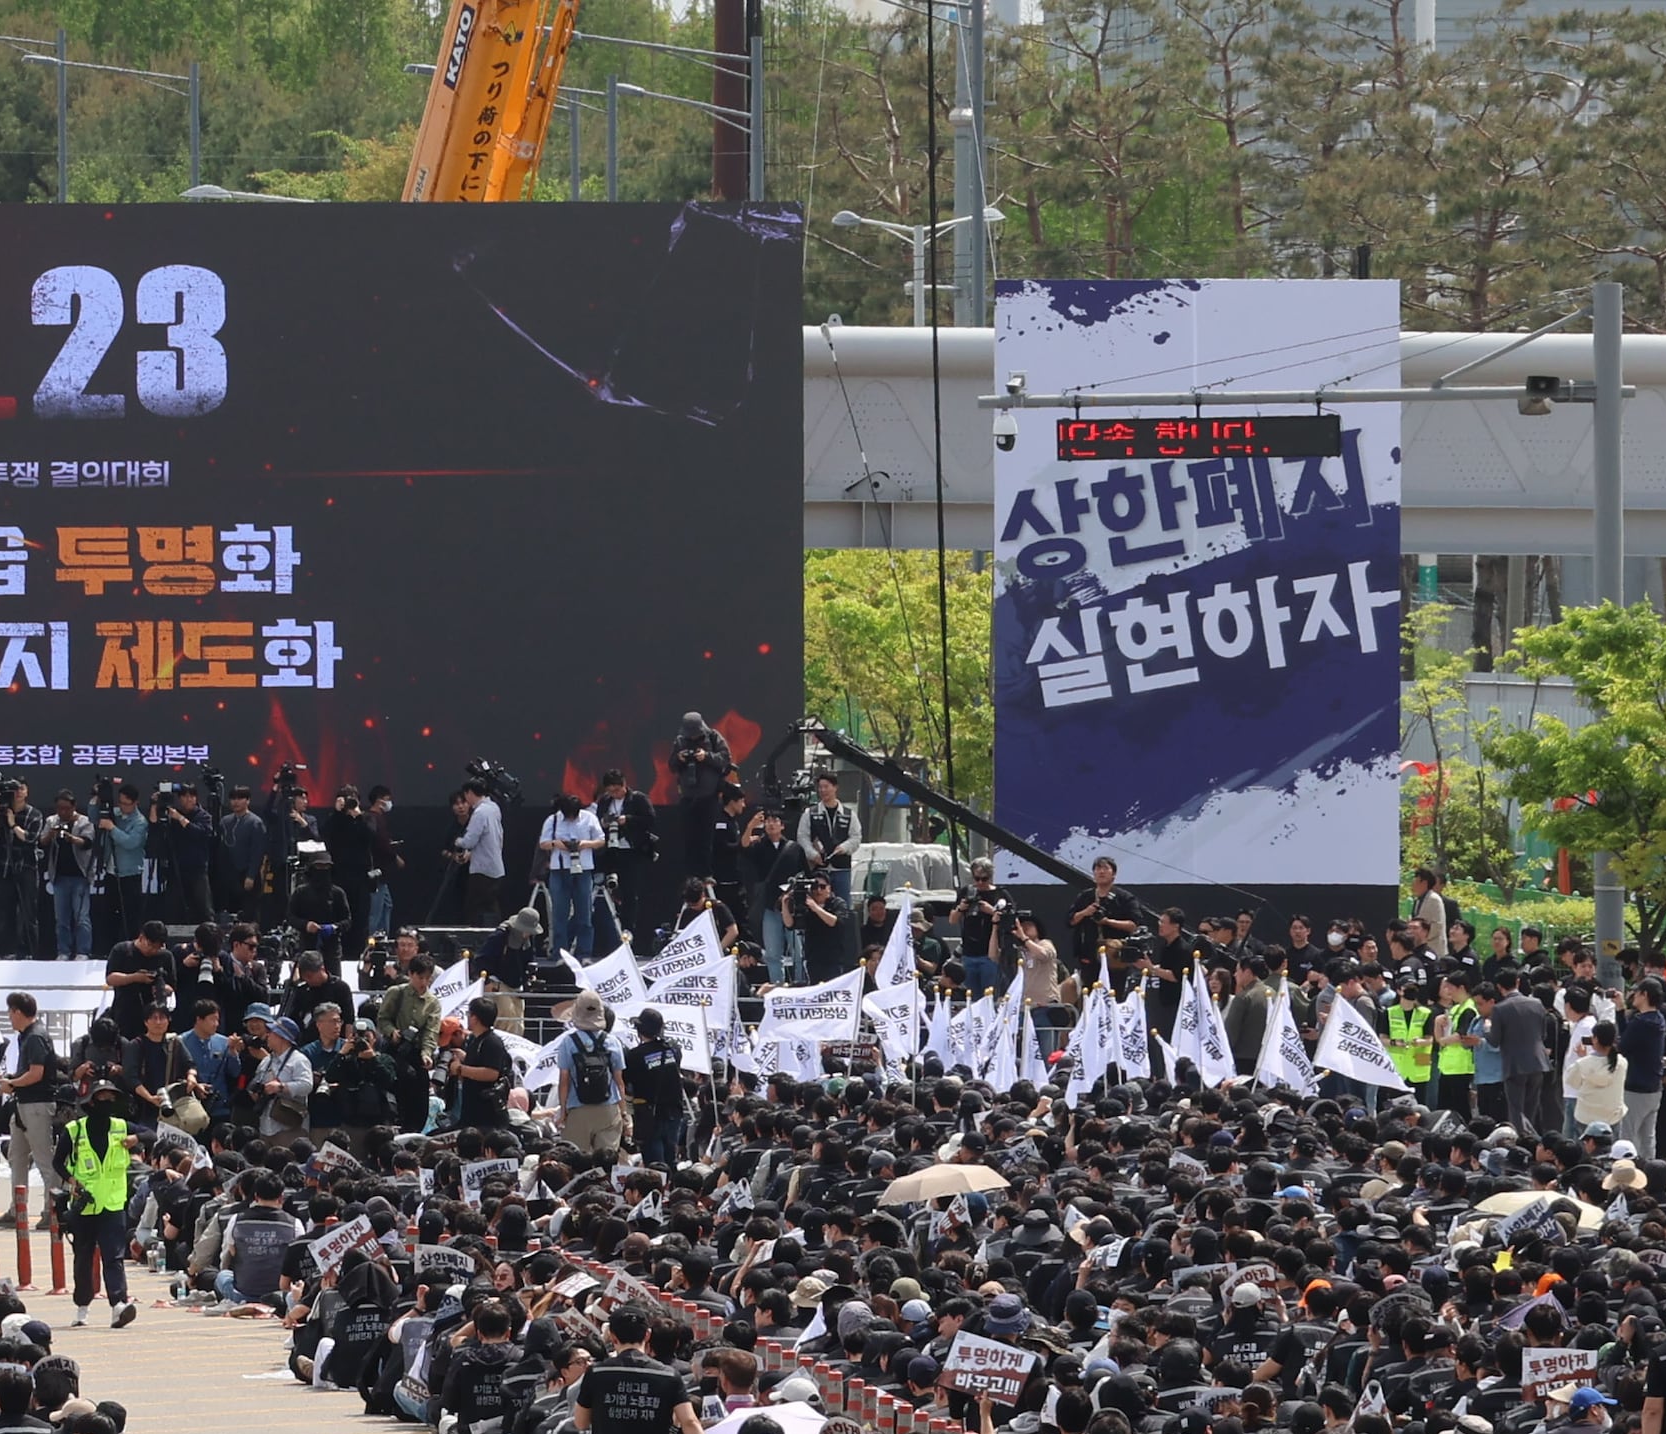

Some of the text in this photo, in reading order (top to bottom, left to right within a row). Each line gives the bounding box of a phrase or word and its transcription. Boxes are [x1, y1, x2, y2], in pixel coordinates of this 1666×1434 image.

[50, 461, 169, 489] 결의대회
[1000, 429, 1373, 578] 상한폐지
[55, 523, 302, 595] 투명화
[1026, 560, 1401, 708] 실현하자
[95, 619, 342, 689] 제도화
[72, 745, 209, 766] 공동투쟁본부
[318, 1222, 364, 1262] 투명하게
[419, 1252, 468, 1269] 상한폐지
[956, 1346, 1023, 1368] 투명하게
[1528, 1352, 1589, 1375] 투명하게
[617, 1381, 649, 1393] 삼성그룹
[955, 1372, 1020, 1396] 바꾸고!!!
[604, 1393, 660, 1408] 초기업 노동조합
[608, 1407, 656, 1420] 삼성전자 지부
